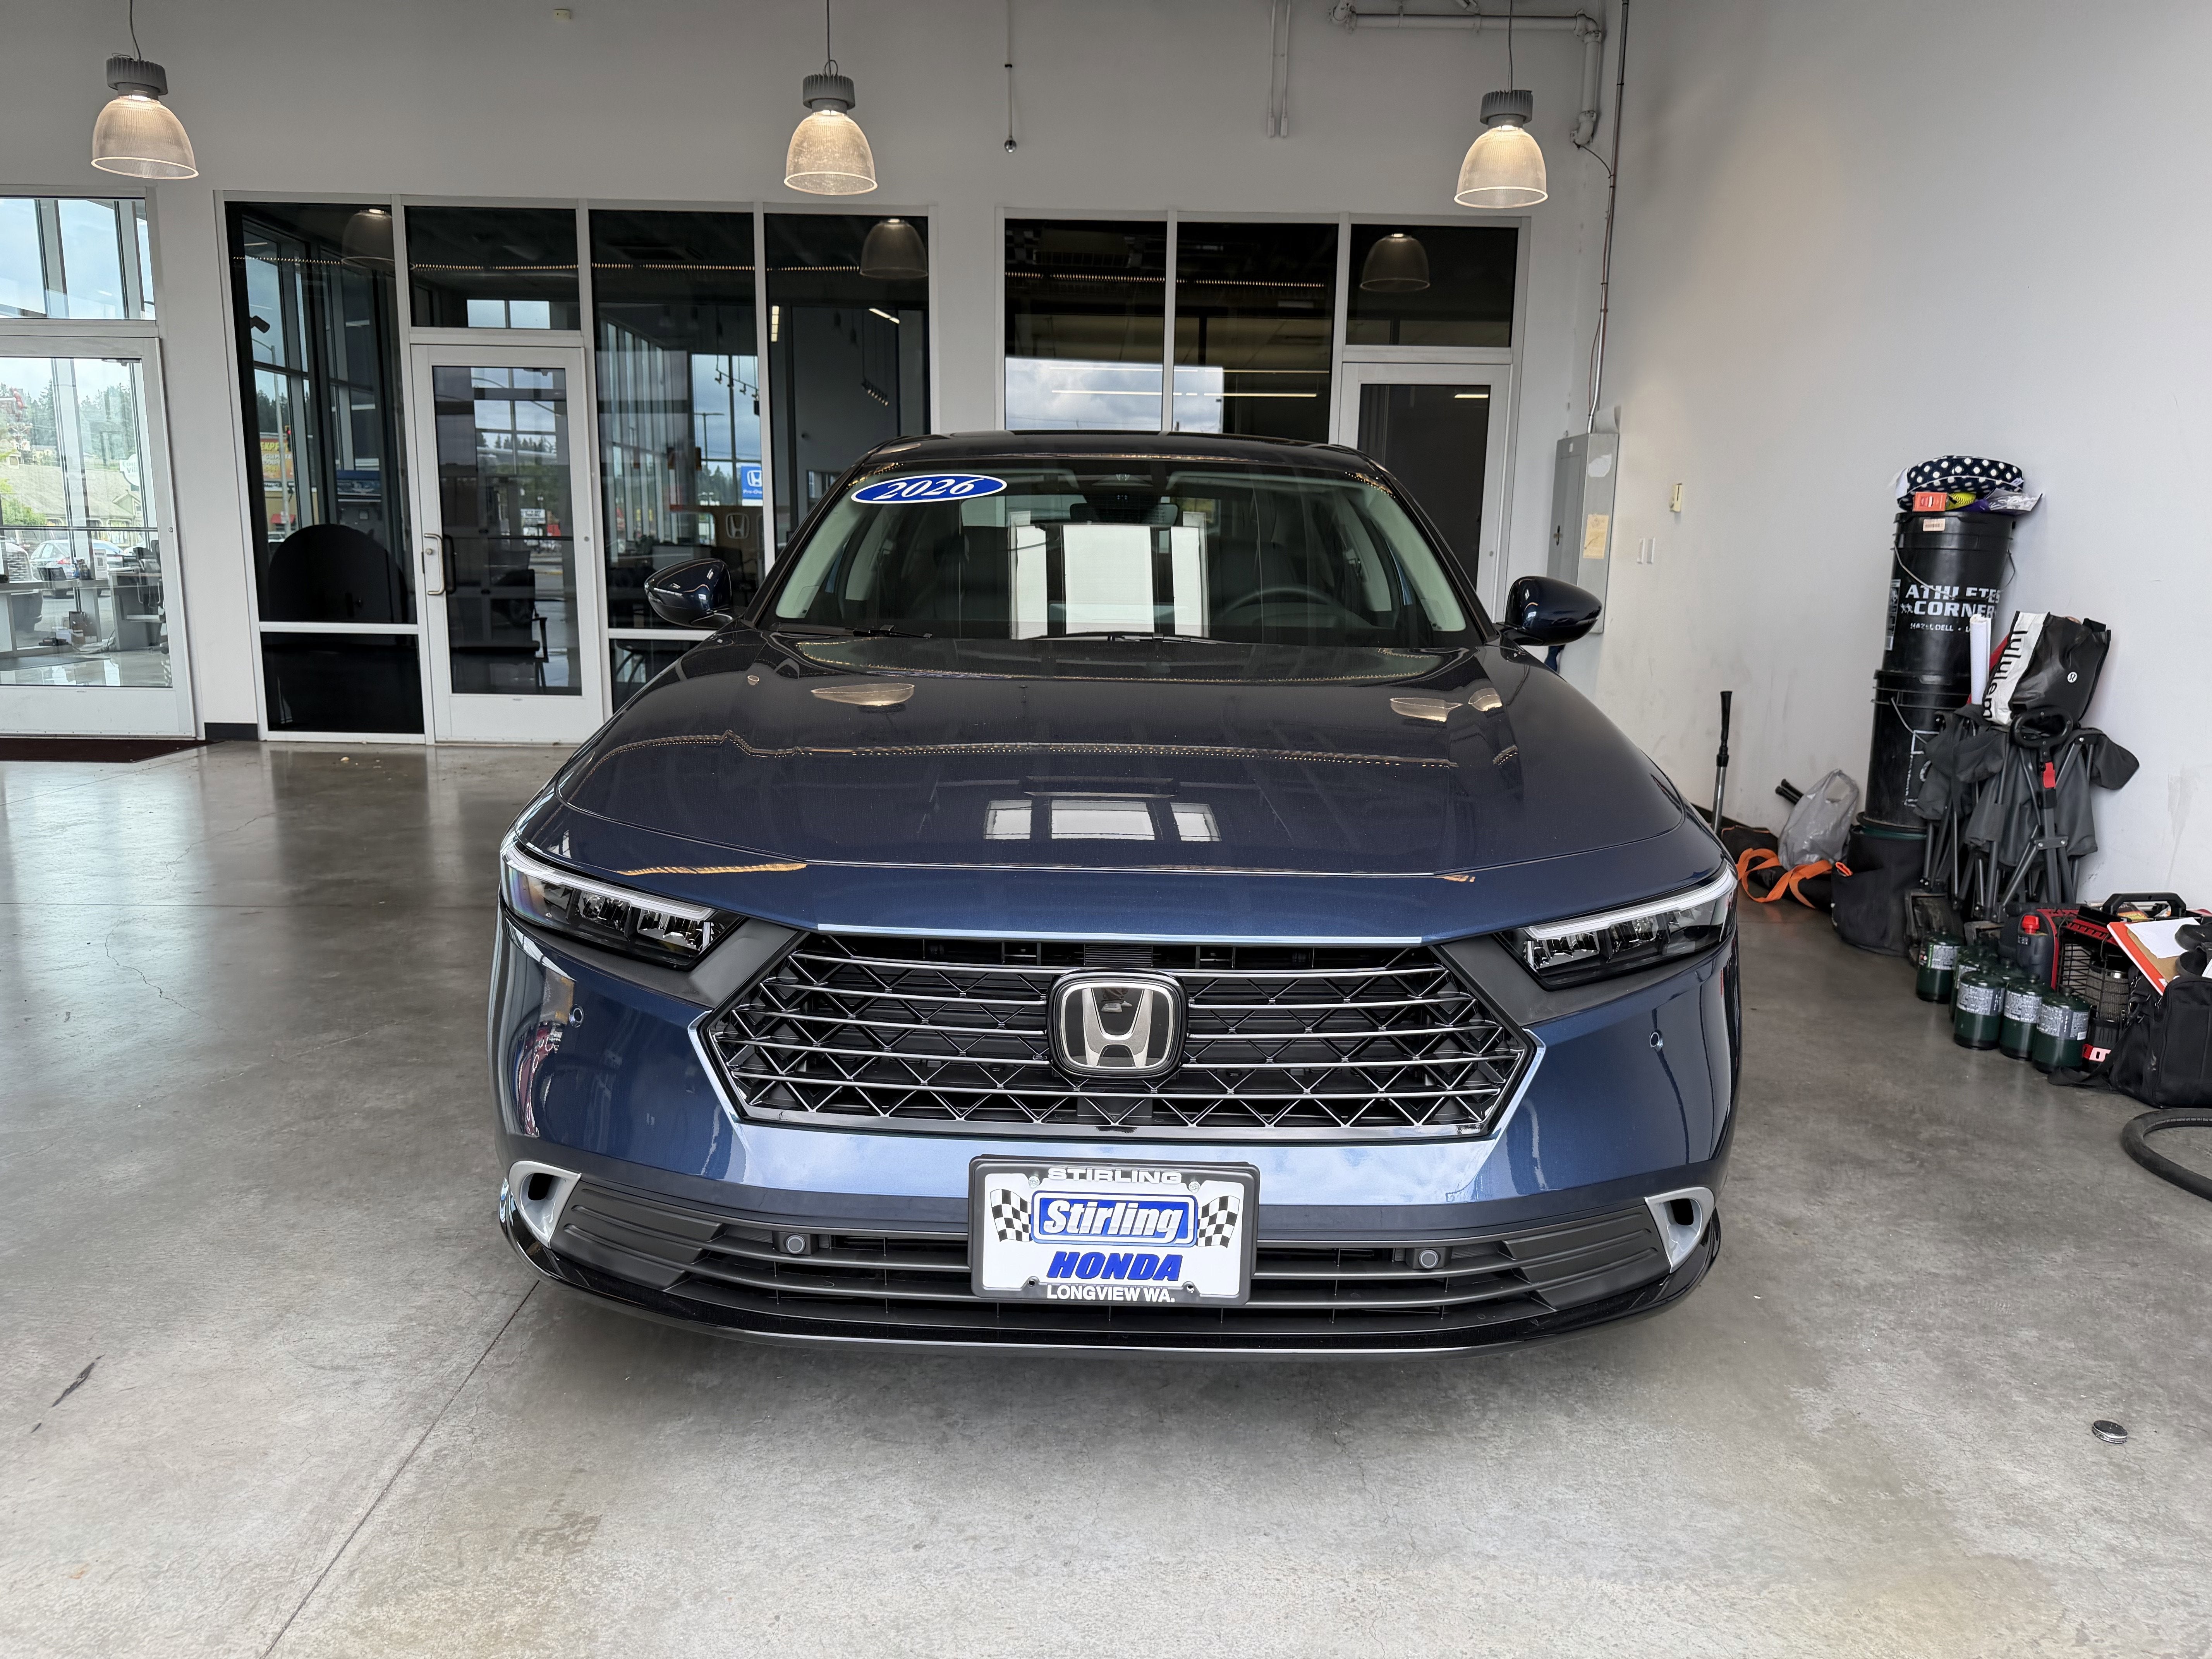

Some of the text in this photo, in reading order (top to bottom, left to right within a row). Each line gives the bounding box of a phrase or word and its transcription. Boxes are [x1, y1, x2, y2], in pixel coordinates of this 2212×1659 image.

[872, 478, 984, 501] 2026
[1905, 584, 2000, 604] ATHLETES
[1914, 601, 1995, 619] CORNER
[1935, 623, 1954, 632] DELL
[1048, 1166, 1182, 1184] STIRLING
[1043, 1200, 1183, 1243] Stirling
[1046, 1251, 1183, 1281] HONDA
[1047, 1285, 1175, 1303] LONGVIEW WA.
